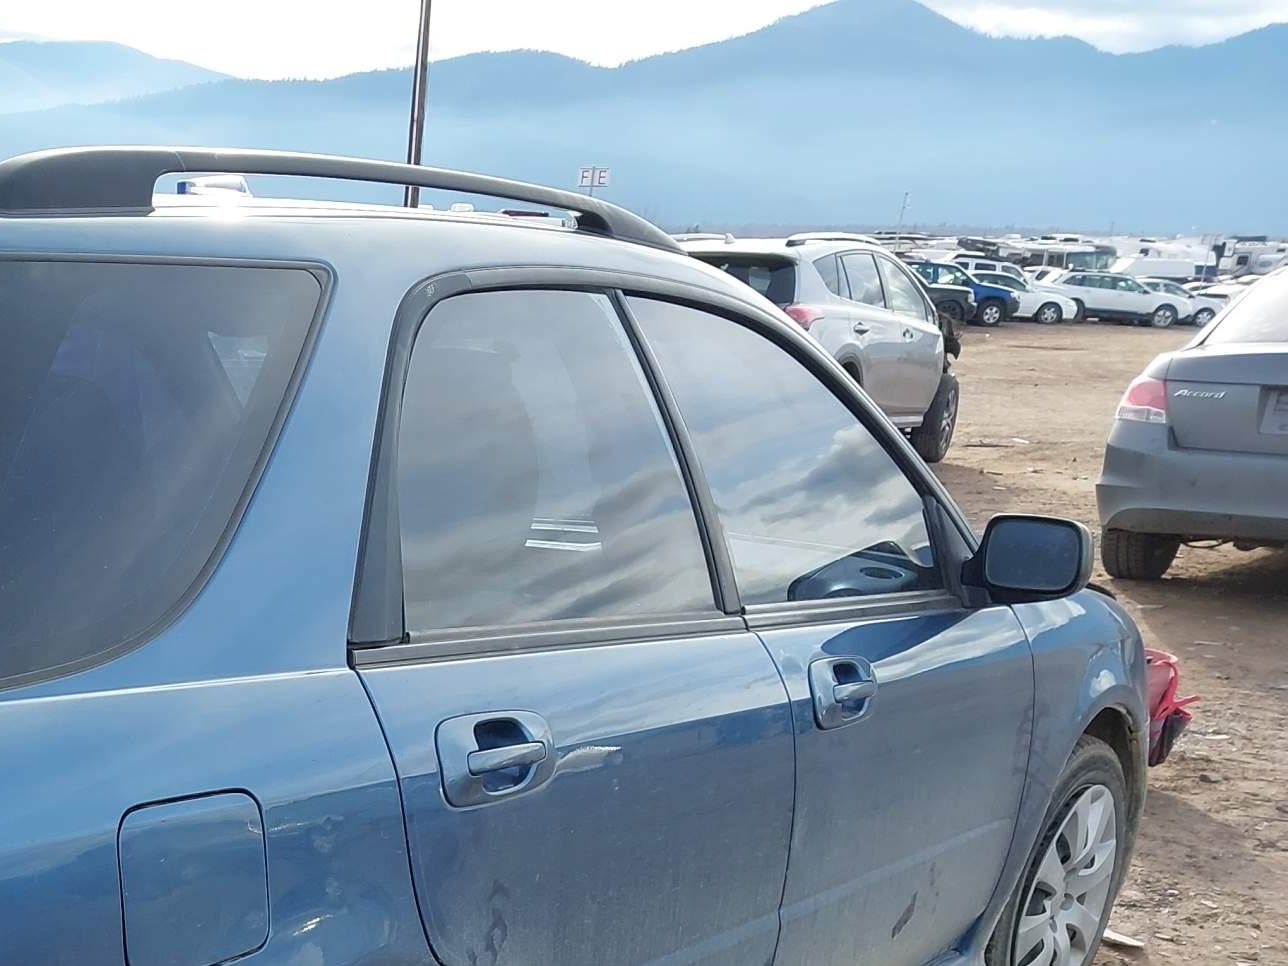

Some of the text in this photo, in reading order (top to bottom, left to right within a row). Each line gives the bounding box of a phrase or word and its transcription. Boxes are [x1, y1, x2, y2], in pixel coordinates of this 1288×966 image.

[581, 170, 607, 184] F E
[1173, 389, 1227, 399] Accord
